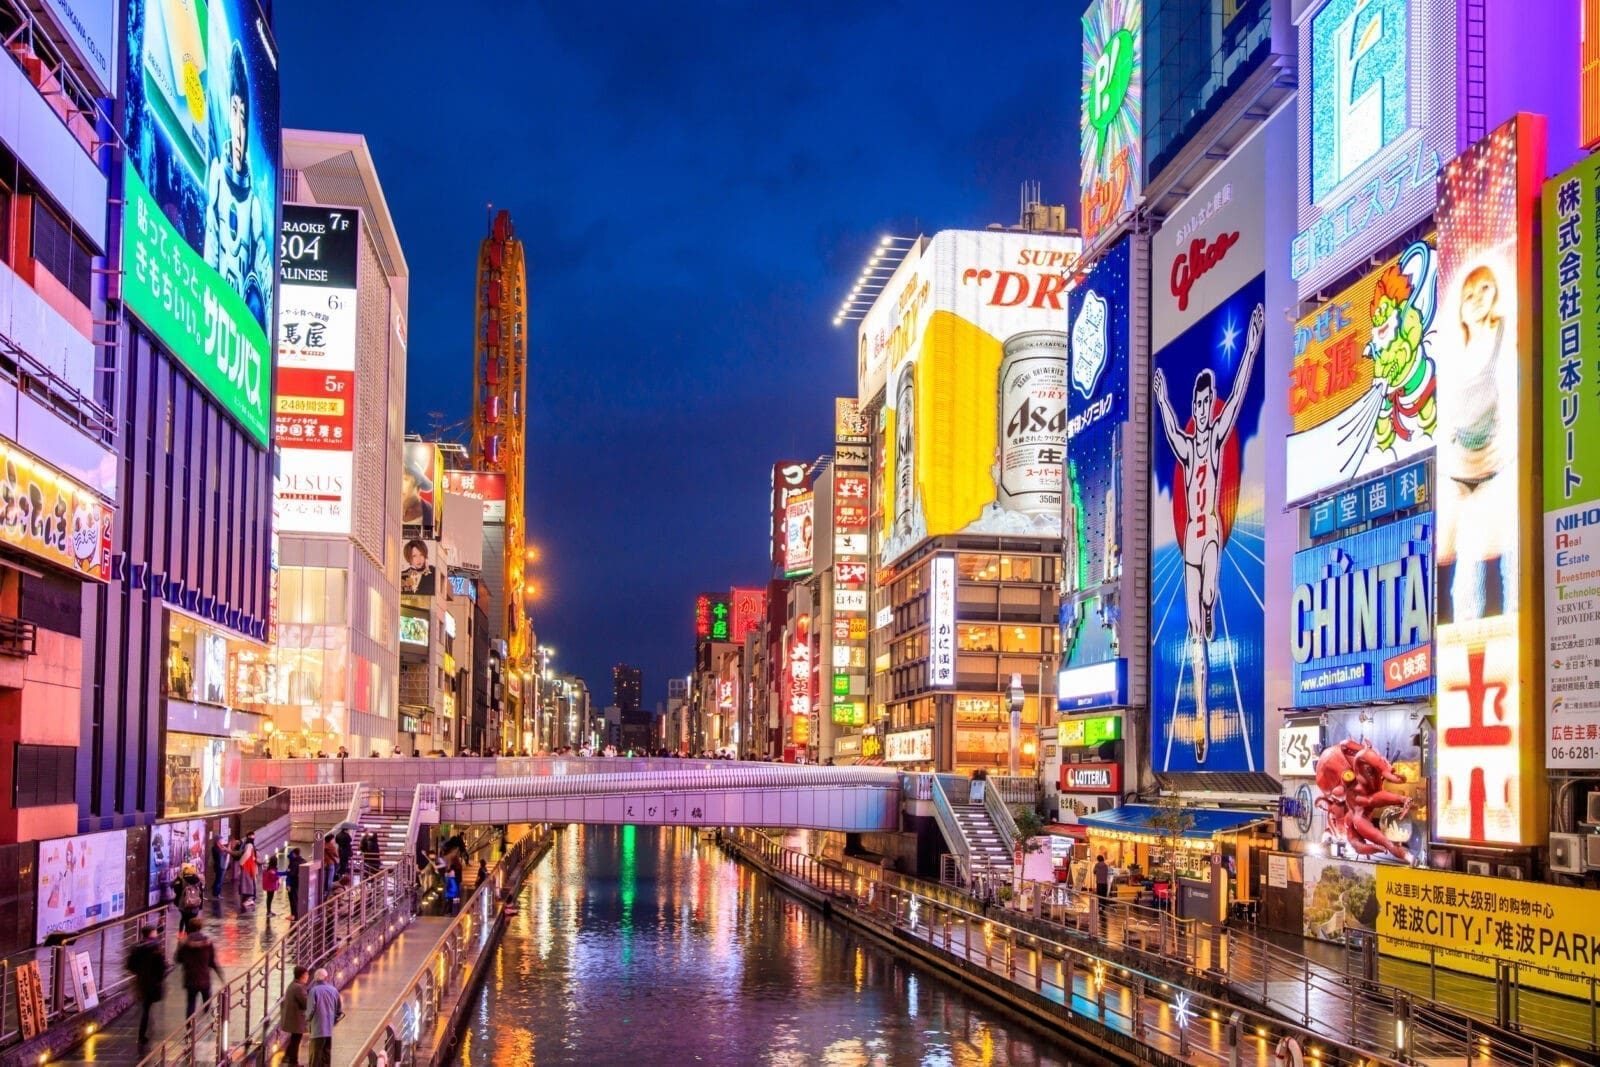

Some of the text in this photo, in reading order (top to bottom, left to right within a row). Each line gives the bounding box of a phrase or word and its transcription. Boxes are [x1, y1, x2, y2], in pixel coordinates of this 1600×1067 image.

[1291, 139, 1441, 281] 日商エステム
[281, 221, 326, 234] RAOKE
[329, 212, 350, 231] 7F
[1170, 231, 1240, 312] Glico
[1294, 302, 1353, 356] かぜに
[1558, 178, 1583, 498] 株式会社日本リート
[203, 285, 263, 417] サロンパス
[1287, 331, 1361, 417] 改源
[325, 375, 345, 392] 5F
[281, 399, 338, 412] 24時間営業
[1037, 448, 1064, 465] 生
[1039, 494, 1062, 505] 350ml
[1196, 459, 1208, 539] グリコ
[1556, 533, 1582, 550] Real
[1556, 551, 1590, 567] Estate
[1291, 550, 1432, 665] CHINTA
[1556, 600, 1593, 614] SERVICE
[1402, 652, 1427, 680] 検索
[1552, 724, 1600, 741] 広告主募
[1551, 747, 1600, 759] 06-6281-
[1075, 770, 1108, 785] LOTTERIA
[627, 806, 702, 818] えびす橋
